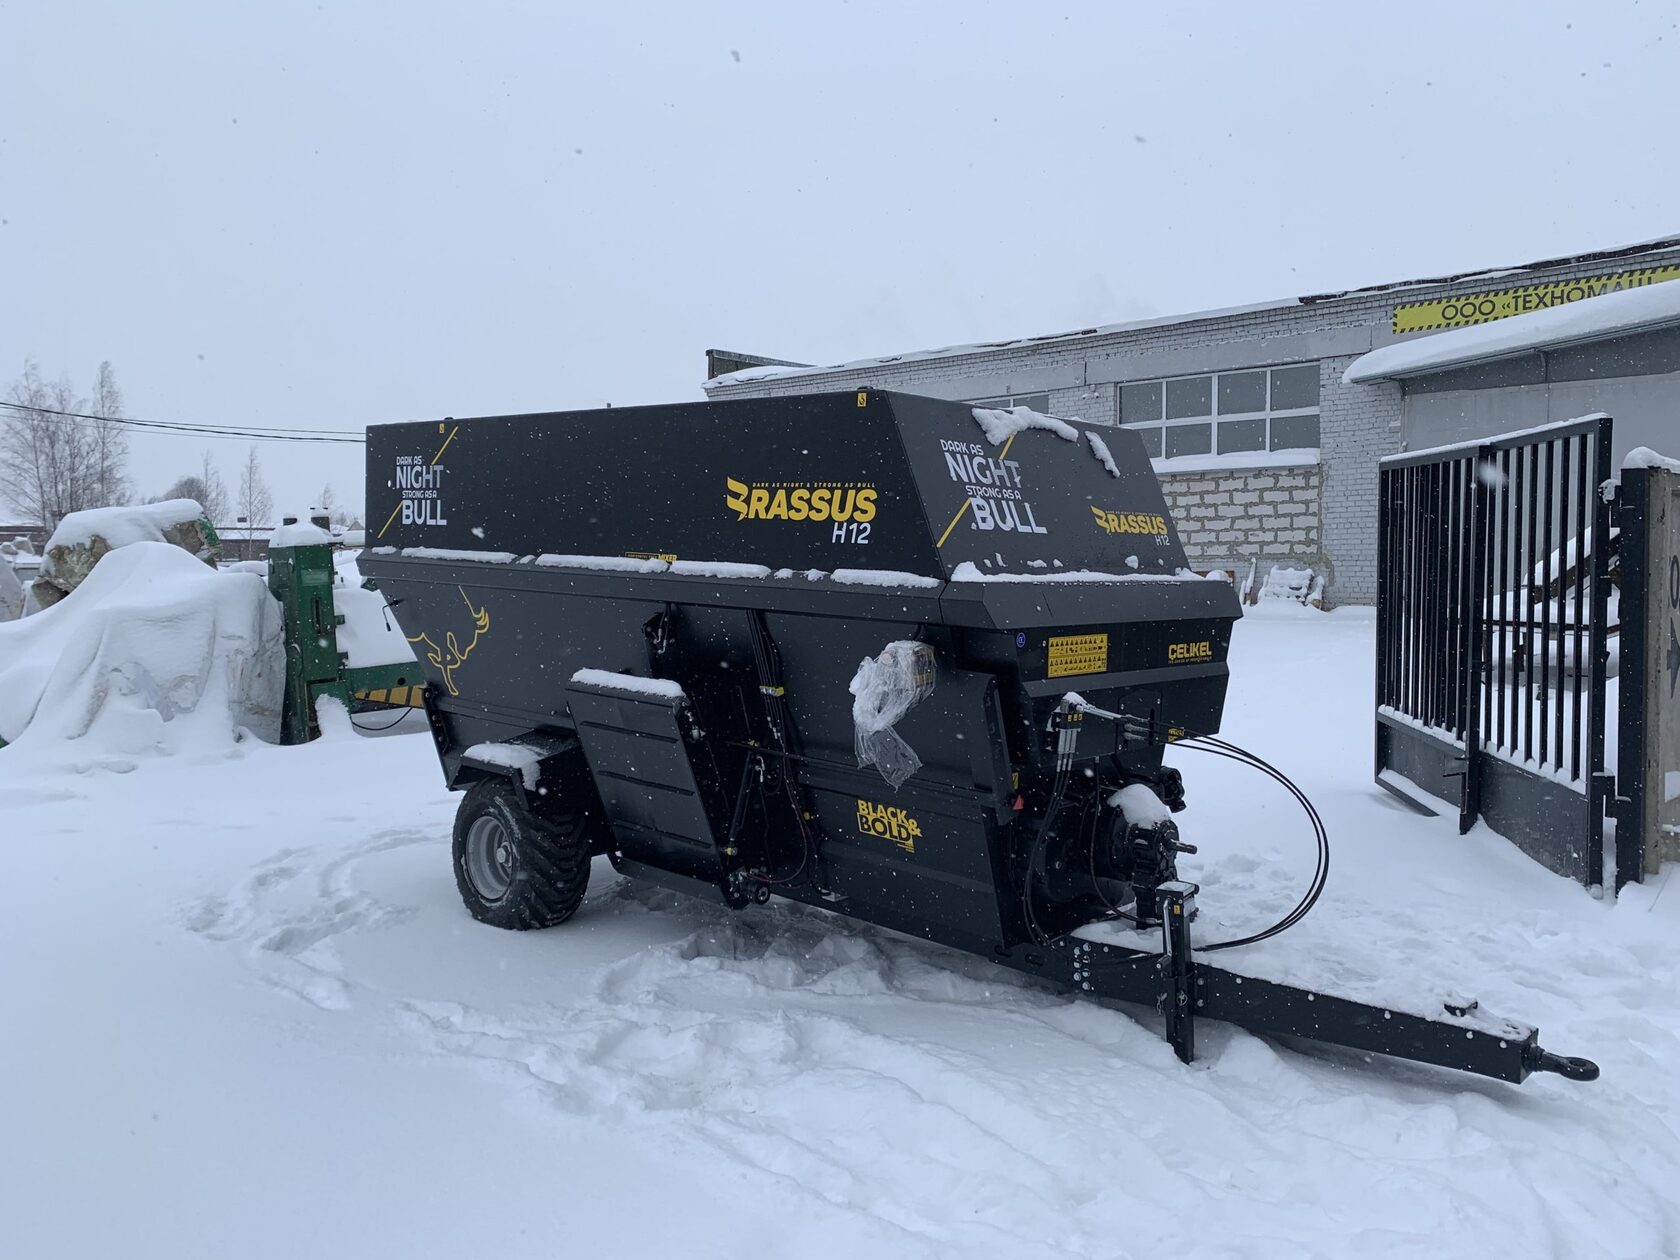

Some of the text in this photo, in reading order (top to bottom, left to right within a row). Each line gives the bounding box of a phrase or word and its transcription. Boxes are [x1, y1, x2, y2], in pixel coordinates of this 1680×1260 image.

[1441, 298, 1496, 321] ООО
[940, 439, 984, 456] DARK AS
[396, 455, 423, 466] DARK AS
[944, 451, 1022, 488] NIGHT
[396, 464, 444, 489] NIGHT
[402, 490, 424, 499] STRONG
[726, 476, 878, 522] BRASSUS
[966, 485, 1002, 498] STRONG
[402, 499, 447, 526] BULL
[969, 496, 1048, 534] BULL
[1090, 505, 1168, 535] BRASSUS
[831, 522, 872, 544] H12
[1154, 535, 1171, 546] H12
[858, 814, 911, 842] BOLD
